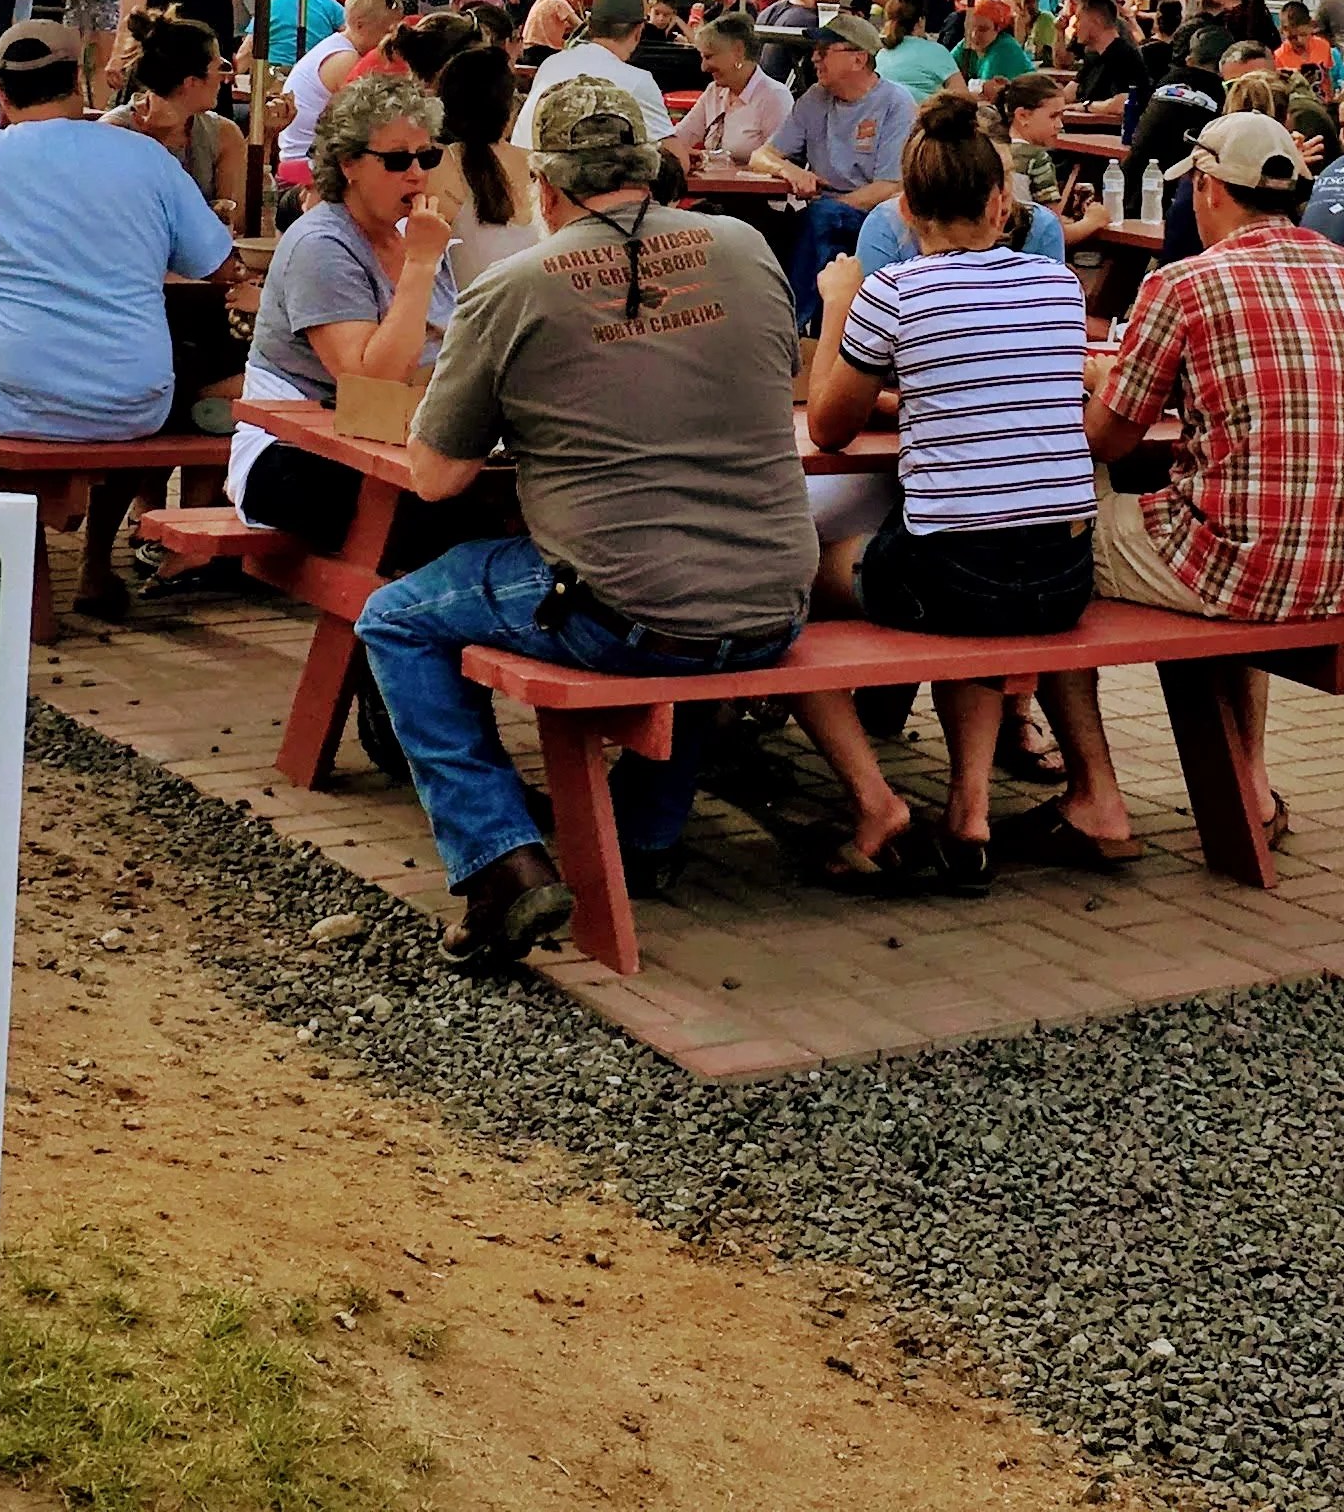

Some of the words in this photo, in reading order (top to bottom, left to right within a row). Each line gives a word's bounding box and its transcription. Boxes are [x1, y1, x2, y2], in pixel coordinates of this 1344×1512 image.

[571, 270, 594, 292] OF
[592, 321, 646, 345] NORTH
[650, 301, 727, 335] CAROLINA
